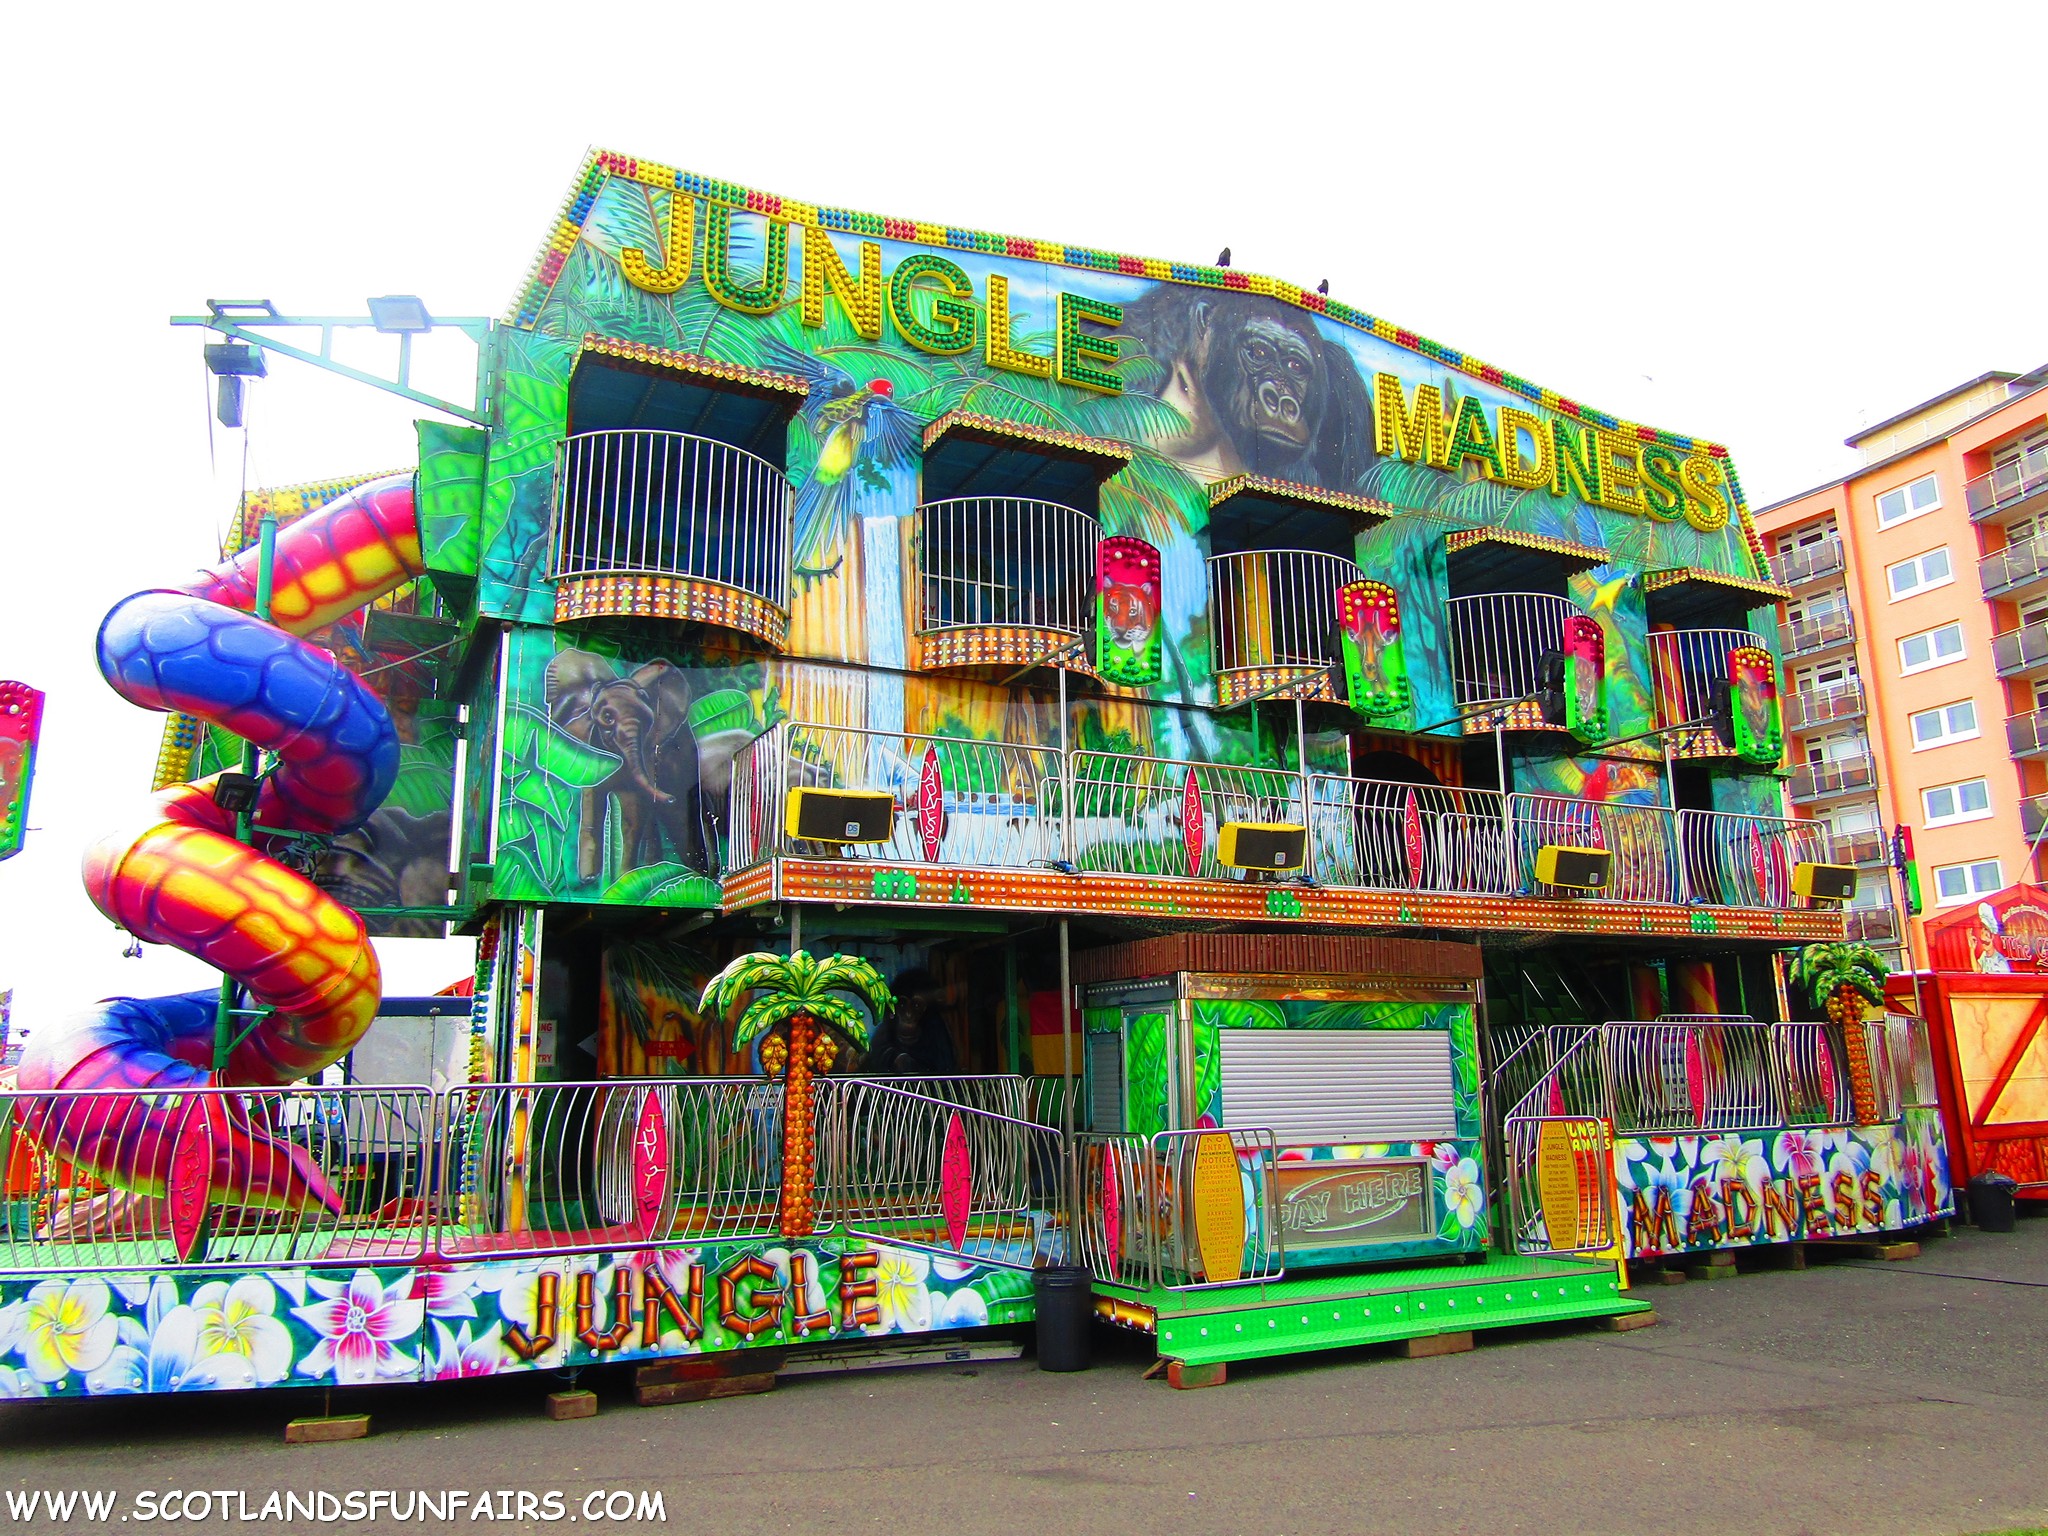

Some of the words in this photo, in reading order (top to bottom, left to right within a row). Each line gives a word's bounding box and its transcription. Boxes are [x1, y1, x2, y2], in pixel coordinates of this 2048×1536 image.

[619, 192, 1123, 395] JUNGLE
[1373, 372, 1728, 531] MADNESS
[1271, 1190, 1331, 1236] PAY
[1338, 1167, 1423, 1214] HERE
[1633, 1171, 1885, 1250] MADNESS
[501, 1251, 880, 1360] JUNGLE
